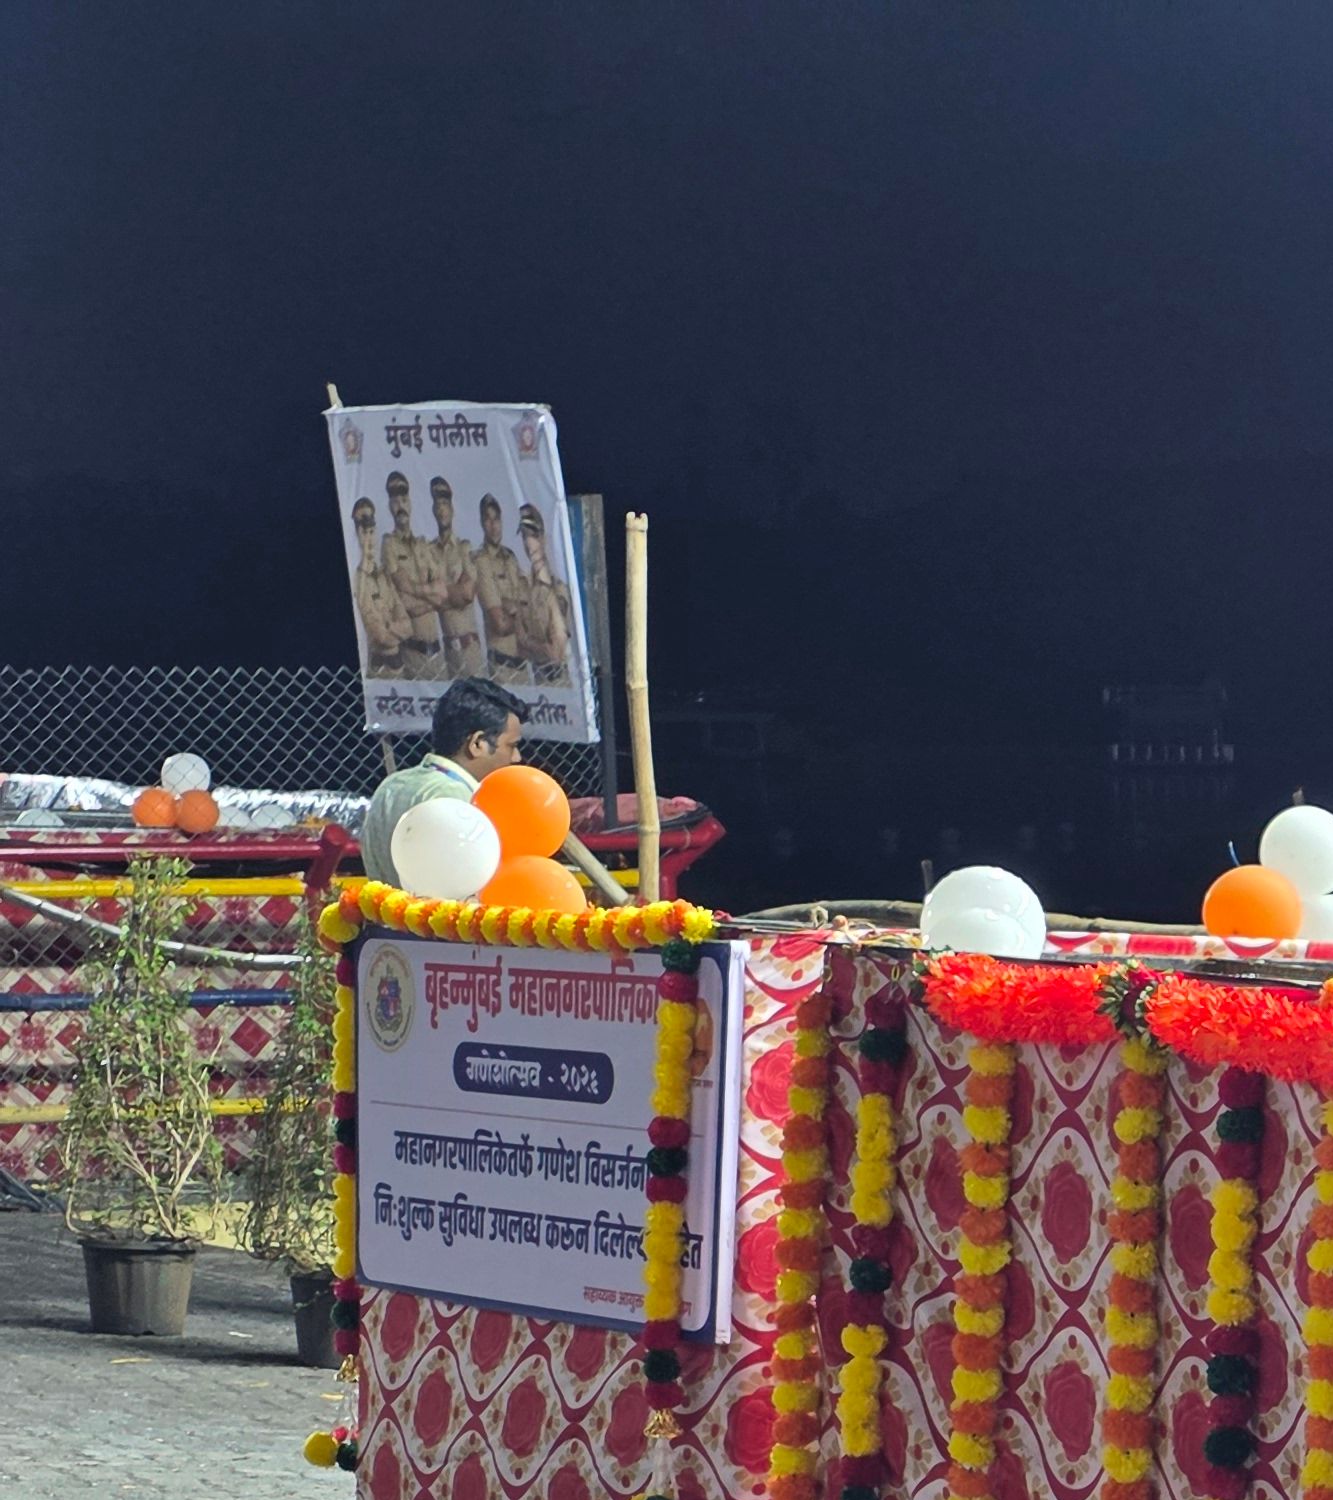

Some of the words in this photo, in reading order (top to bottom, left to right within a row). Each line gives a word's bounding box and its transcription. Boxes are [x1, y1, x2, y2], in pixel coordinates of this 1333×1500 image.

[385, 414, 423, 458] मुंबई
[427, 412, 488, 448] पोलीस
[424, 950, 502, 1032] बृहन्मुंबई
[394, 1128, 535, 1178] महानगरपालिकेतर्फे
[537, 1137, 581, 1184] गणेश
[438, 1192, 486, 1247] सुविधा
[488, 1207, 543, 1247] उपलब्ध
